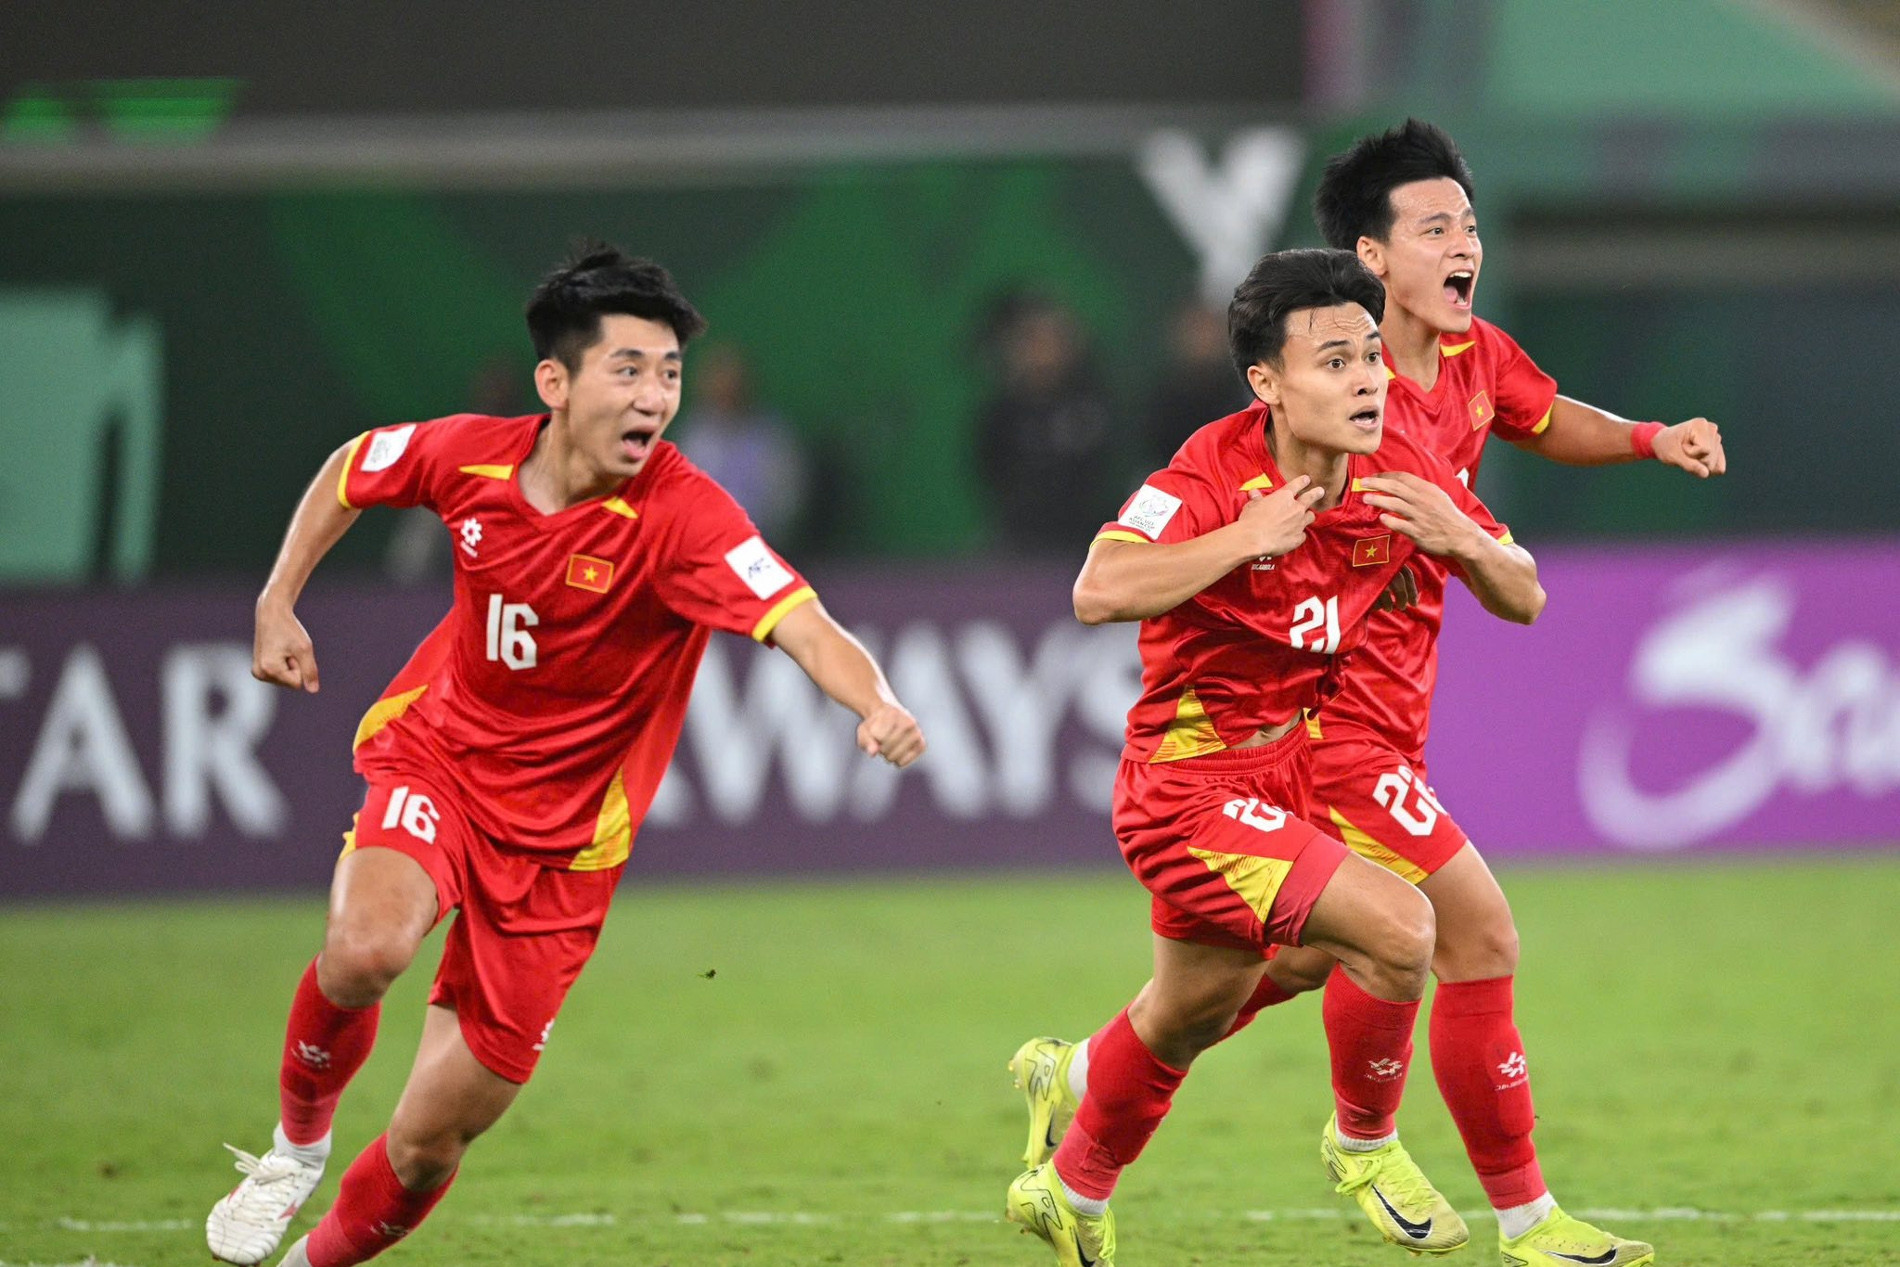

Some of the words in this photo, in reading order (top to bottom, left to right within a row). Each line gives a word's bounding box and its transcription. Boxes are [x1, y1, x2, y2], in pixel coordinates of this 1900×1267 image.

[486, 594, 539, 670] 16
[1289, 594, 1341, 654] 21
[0, 646, 282, 843] AR
[381, 785, 441, 845] 16
